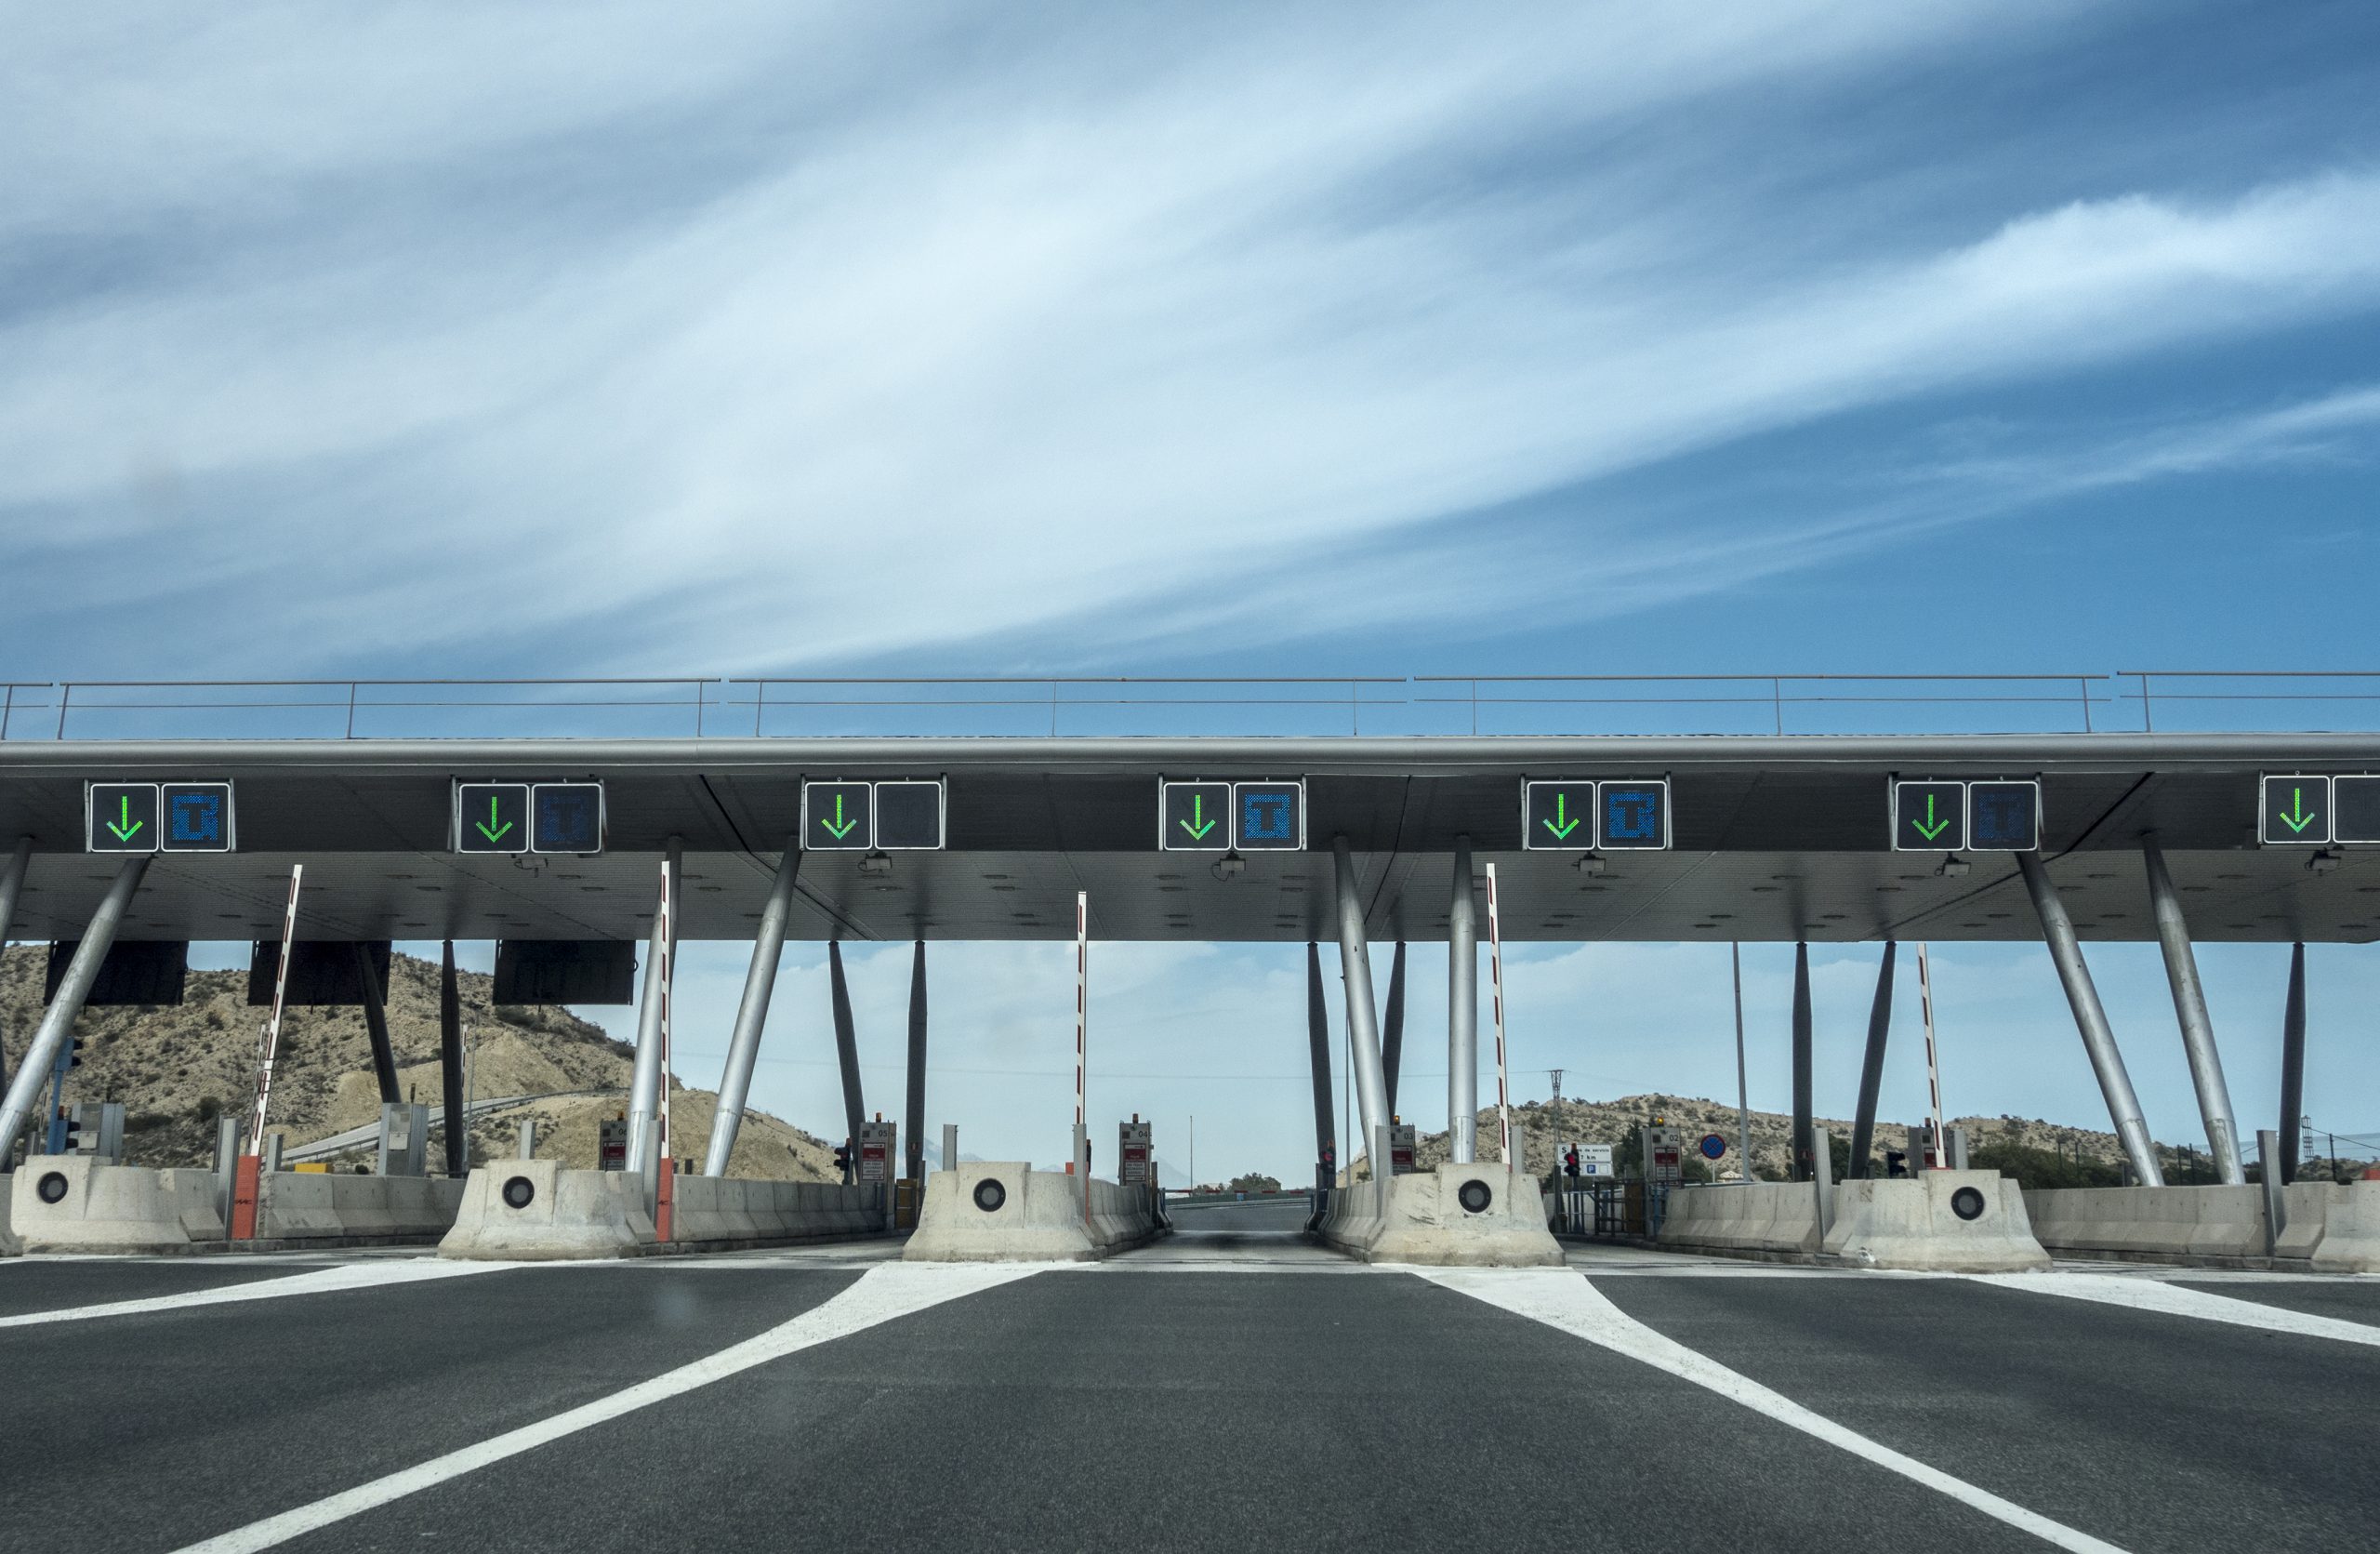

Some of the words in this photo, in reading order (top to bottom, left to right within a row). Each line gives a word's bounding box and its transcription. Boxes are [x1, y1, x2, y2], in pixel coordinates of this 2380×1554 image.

[177, 802, 212, 834] T
[1250, 801, 1284, 833] T
[1613, 799, 1648, 832] T
